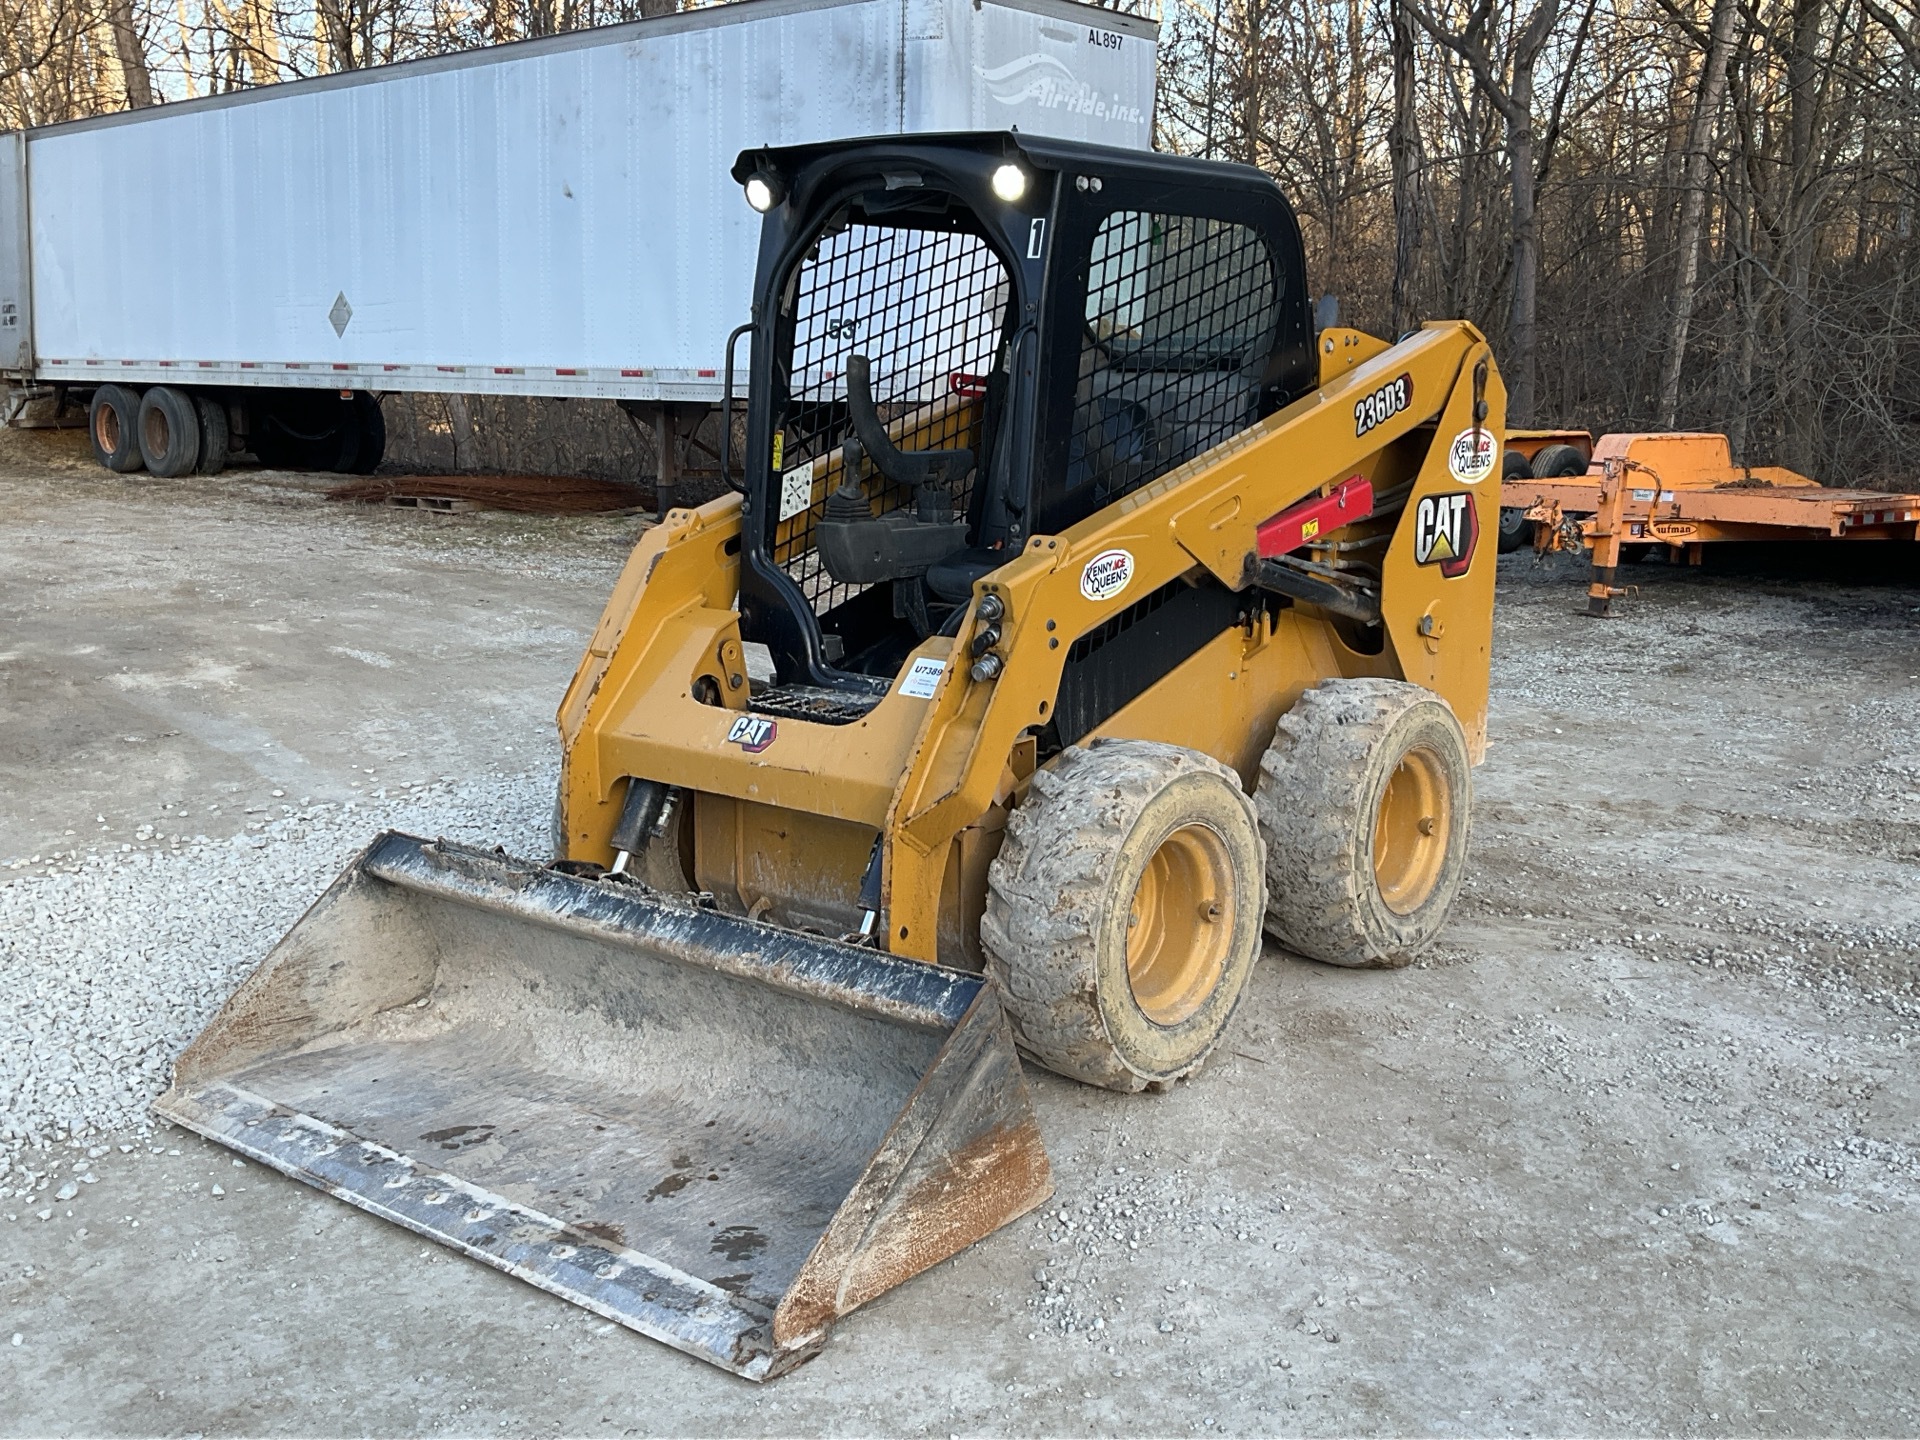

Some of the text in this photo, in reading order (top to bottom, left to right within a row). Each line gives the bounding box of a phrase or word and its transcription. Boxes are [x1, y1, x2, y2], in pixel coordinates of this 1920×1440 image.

[1088, 29, 1123, 51] AL897
[1030, 219, 1044, 257] 1
[1355, 378, 1406, 436] 236D3
[1416, 494, 1467, 563] CAT
[1086, 557, 1127, 586] KENNY ACE
[728, 717, 773, 746] CAT
